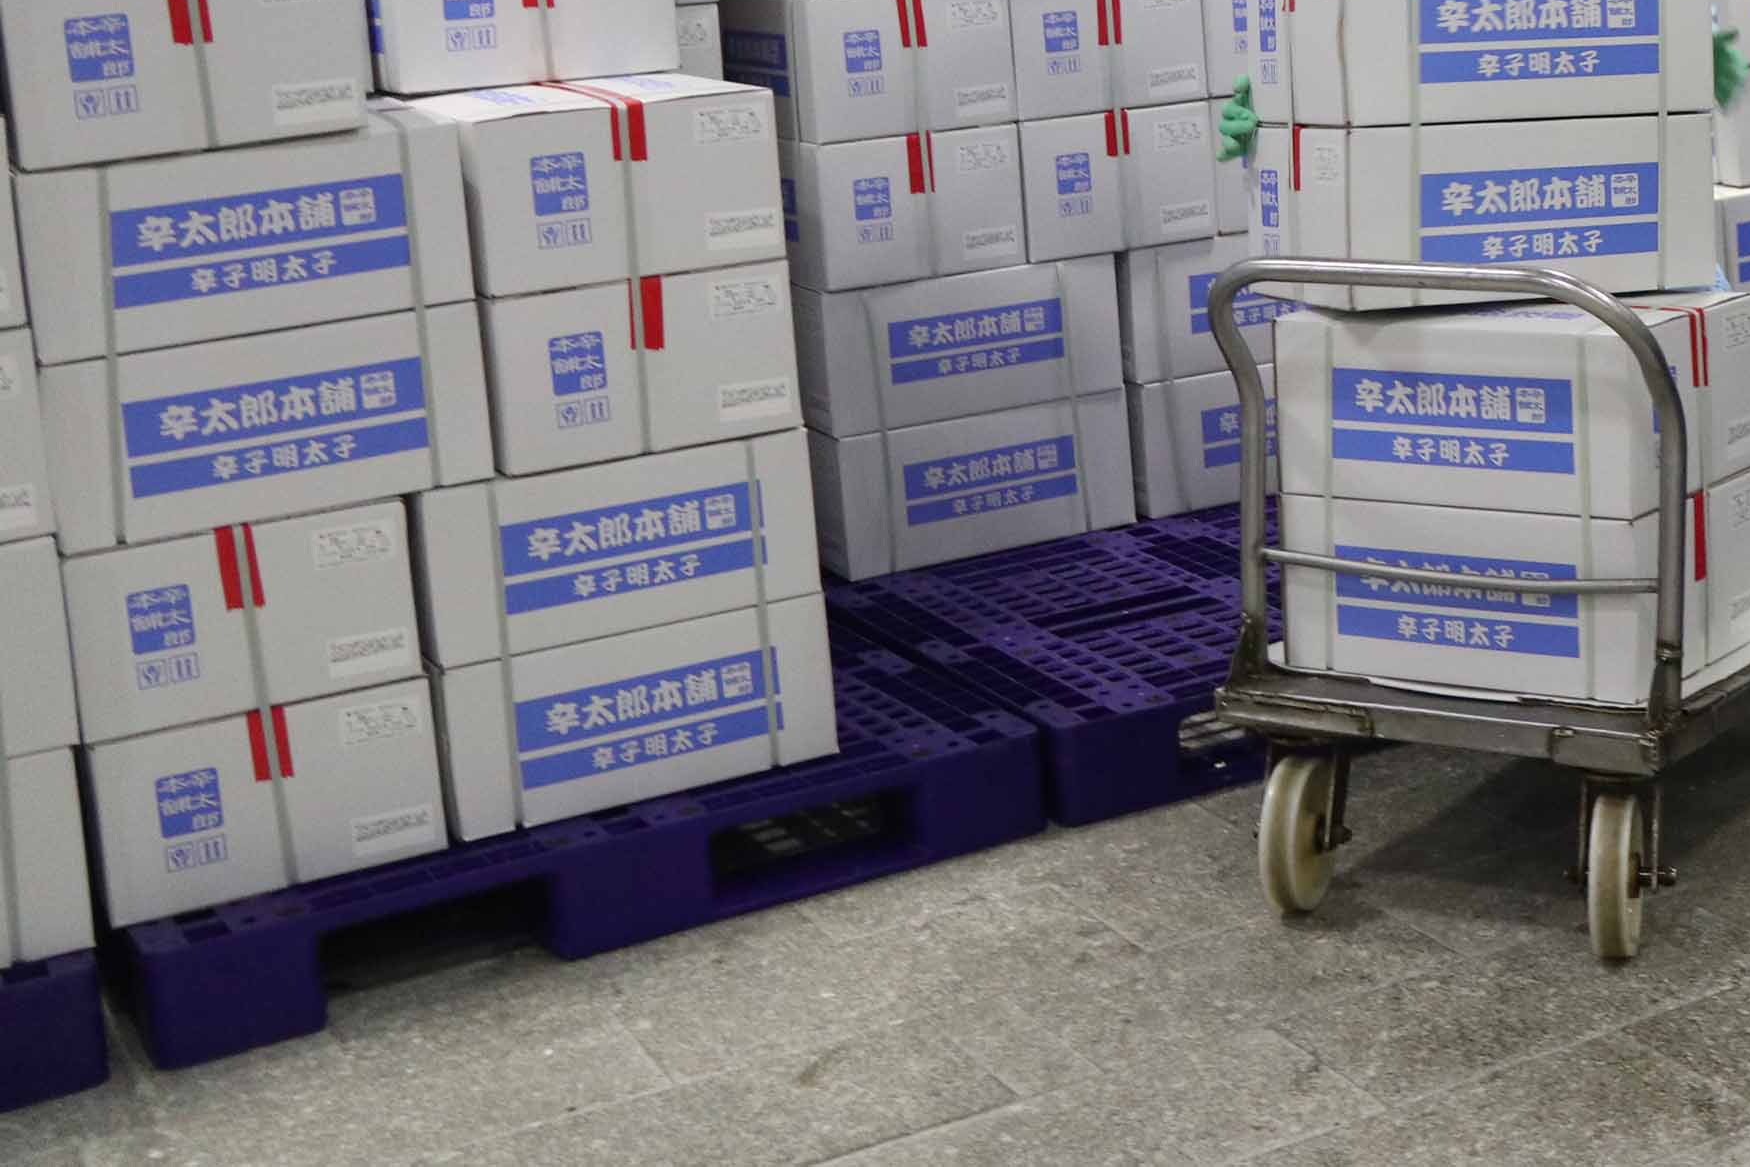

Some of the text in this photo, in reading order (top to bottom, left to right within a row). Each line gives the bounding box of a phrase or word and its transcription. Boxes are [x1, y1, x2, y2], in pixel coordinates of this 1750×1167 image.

[1478, 50, 1599, 77] 辛子明太子
[1442, 175, 1605, 216] 辛太郎本舗
[138, 192, 336, 251] 辛太郎本舗
[1483, 230, 1602, 259] 辛子明太子
[192, 250, 336, 293] 辛子明太子
[160, 377, 356, 440] 辛太郎本舗
[1356, 379, 1511, 420] 辛太郎本舗
[213, 434, 356, 479] 辛子明太子
[1393, 436, 1509, 466] 辛子明太子
[528, 500, 701, 560] 辛太郎本舗
[547, 669, 718, 735] 辛太郎本舗
